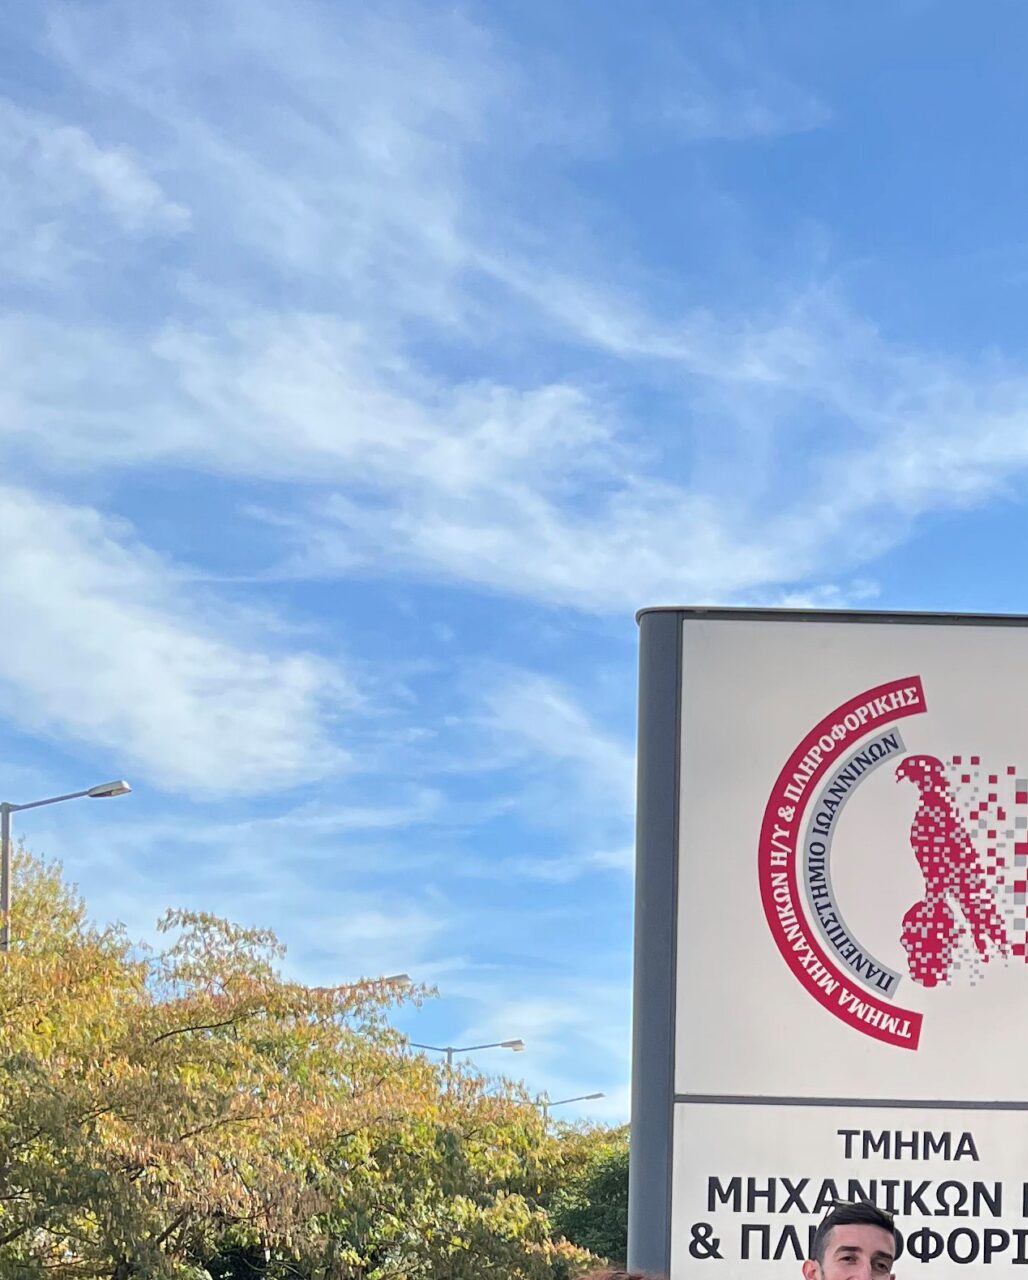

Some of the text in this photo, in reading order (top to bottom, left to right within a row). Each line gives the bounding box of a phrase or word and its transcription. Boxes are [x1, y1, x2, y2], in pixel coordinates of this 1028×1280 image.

[770, 686, 920, 1039] ΤΜΗΜΑ ΜΗΧΑΝΙΚΩΝ Η/Υ & ΠΛΗΡΟΦΟΡΙΚΗΣ
[808, 733, 900, 992] ΠΑΝΕΠΙΣΤΗΜΙΟ ΙΩΑΝΝΙΝΩΝ
[837, 1129, 980, 1162] ΤΜΗΜΑ
[707, 1176, 1003, 1217] ΜΗΧΑΝΙΚΩΝ
[688, 1222, 724, 1260] &
